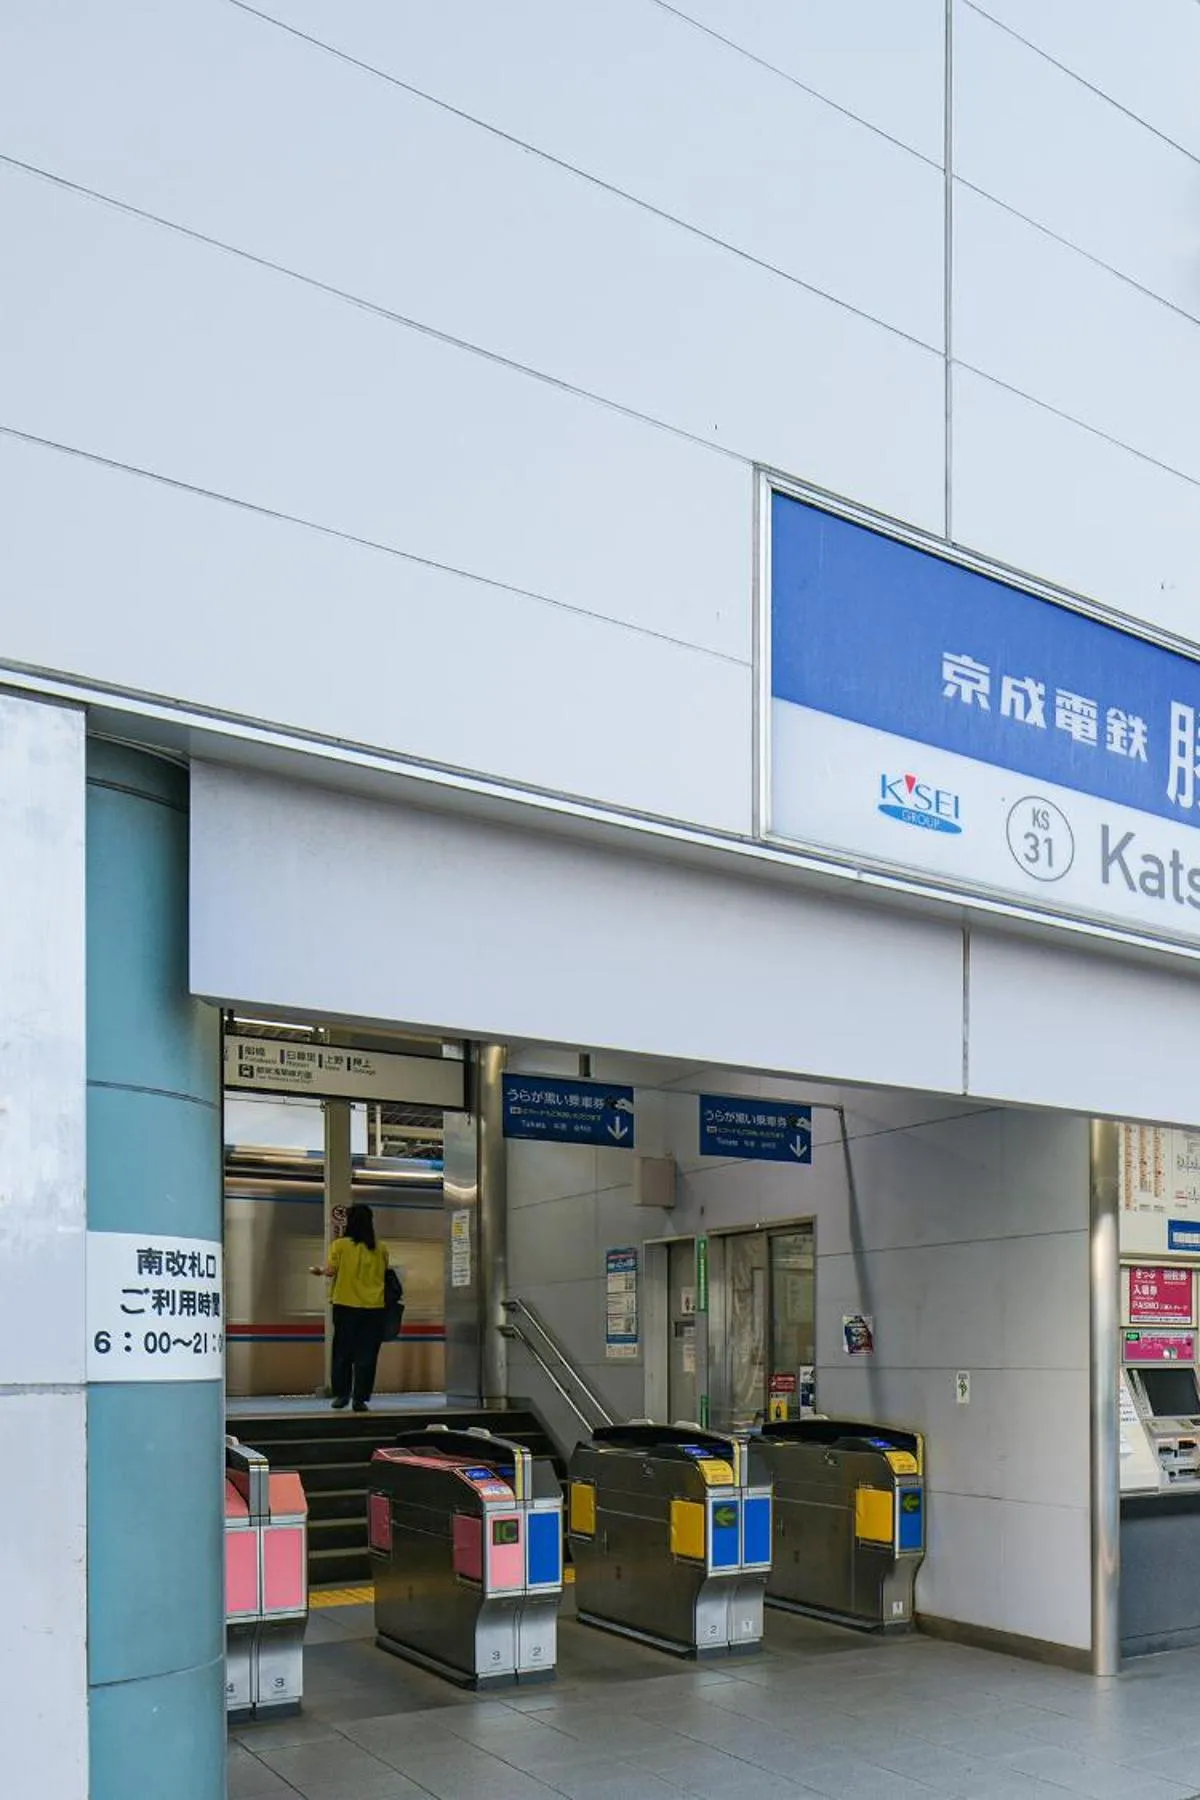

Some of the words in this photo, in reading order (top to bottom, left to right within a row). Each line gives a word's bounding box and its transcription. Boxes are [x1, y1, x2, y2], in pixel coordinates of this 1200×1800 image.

[942, 651, 1149, 764] 京成電鉄
[902, 808, 941, 830] GROUP
[1032, 807, 1050, 831] KS
[1023, 832, 1053, 867] 31
[506, 1088, 604, 1110] うらが黒い乗車券
[704, 1109, 788, 1129] うらが黒い乗車券
[136, 1248, 216, 1278] 南改札口
[120, 1288, 220, 1317] ご利用時間
[495, 1520, 518, 1543] IC
[274, 1677, 285, 1688] 3
